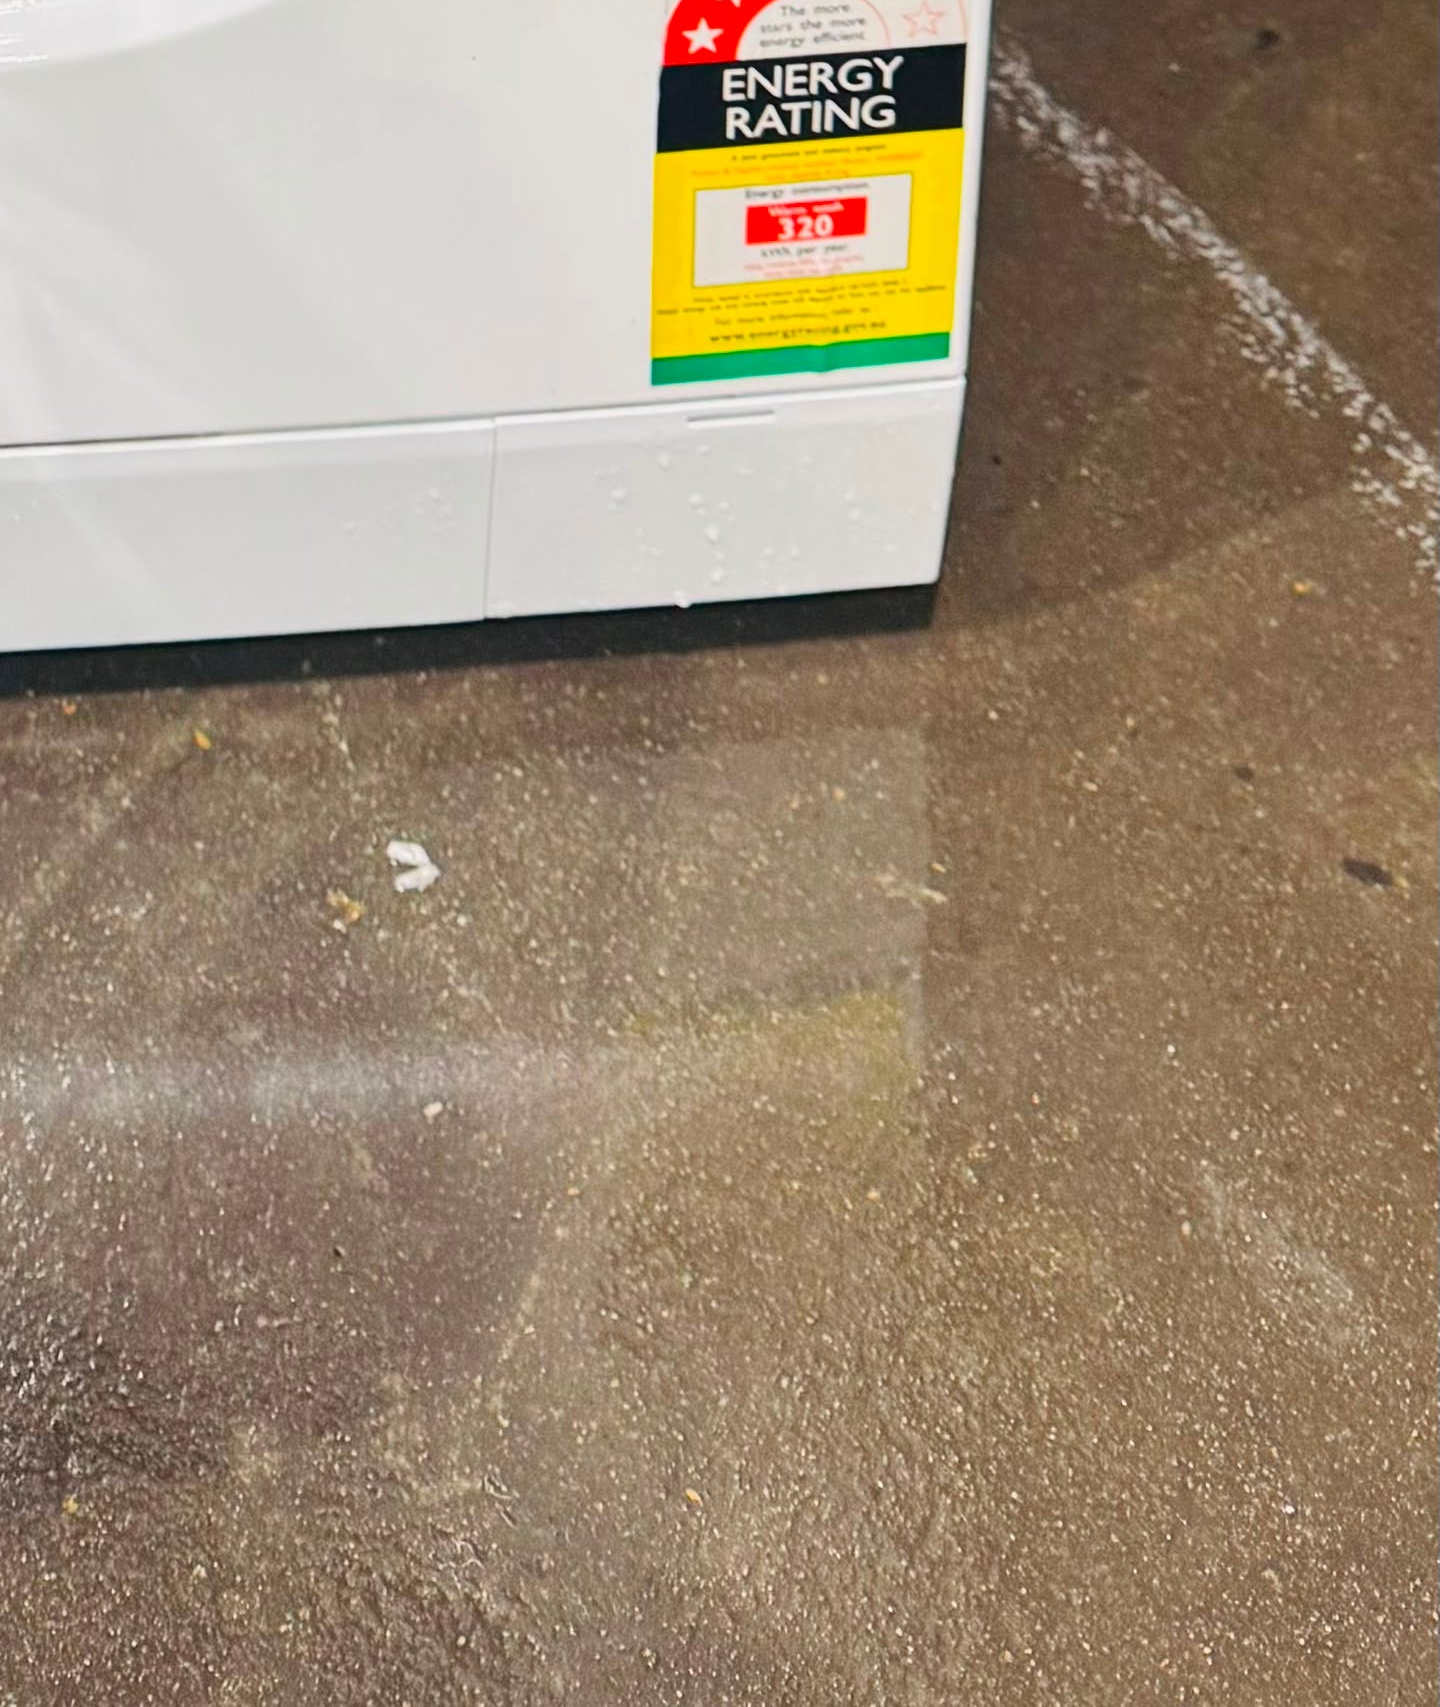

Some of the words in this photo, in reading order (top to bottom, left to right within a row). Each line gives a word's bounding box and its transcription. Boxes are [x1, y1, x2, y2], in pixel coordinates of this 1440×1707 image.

[780, 6, 806, 16] The
[814, 5, 849, 13] more
[761, 23, 792, 32] stars
[801, 20, 821, 29] the
[830, 18, 865, 27] more
[761, 37, 804, 48] energy
[722, 56, 904, 102] ENERGY
[725, 95, 897, 140] RATING
[745, 188, 784, 199] Energy
[777, 215, 833, 240] 320
